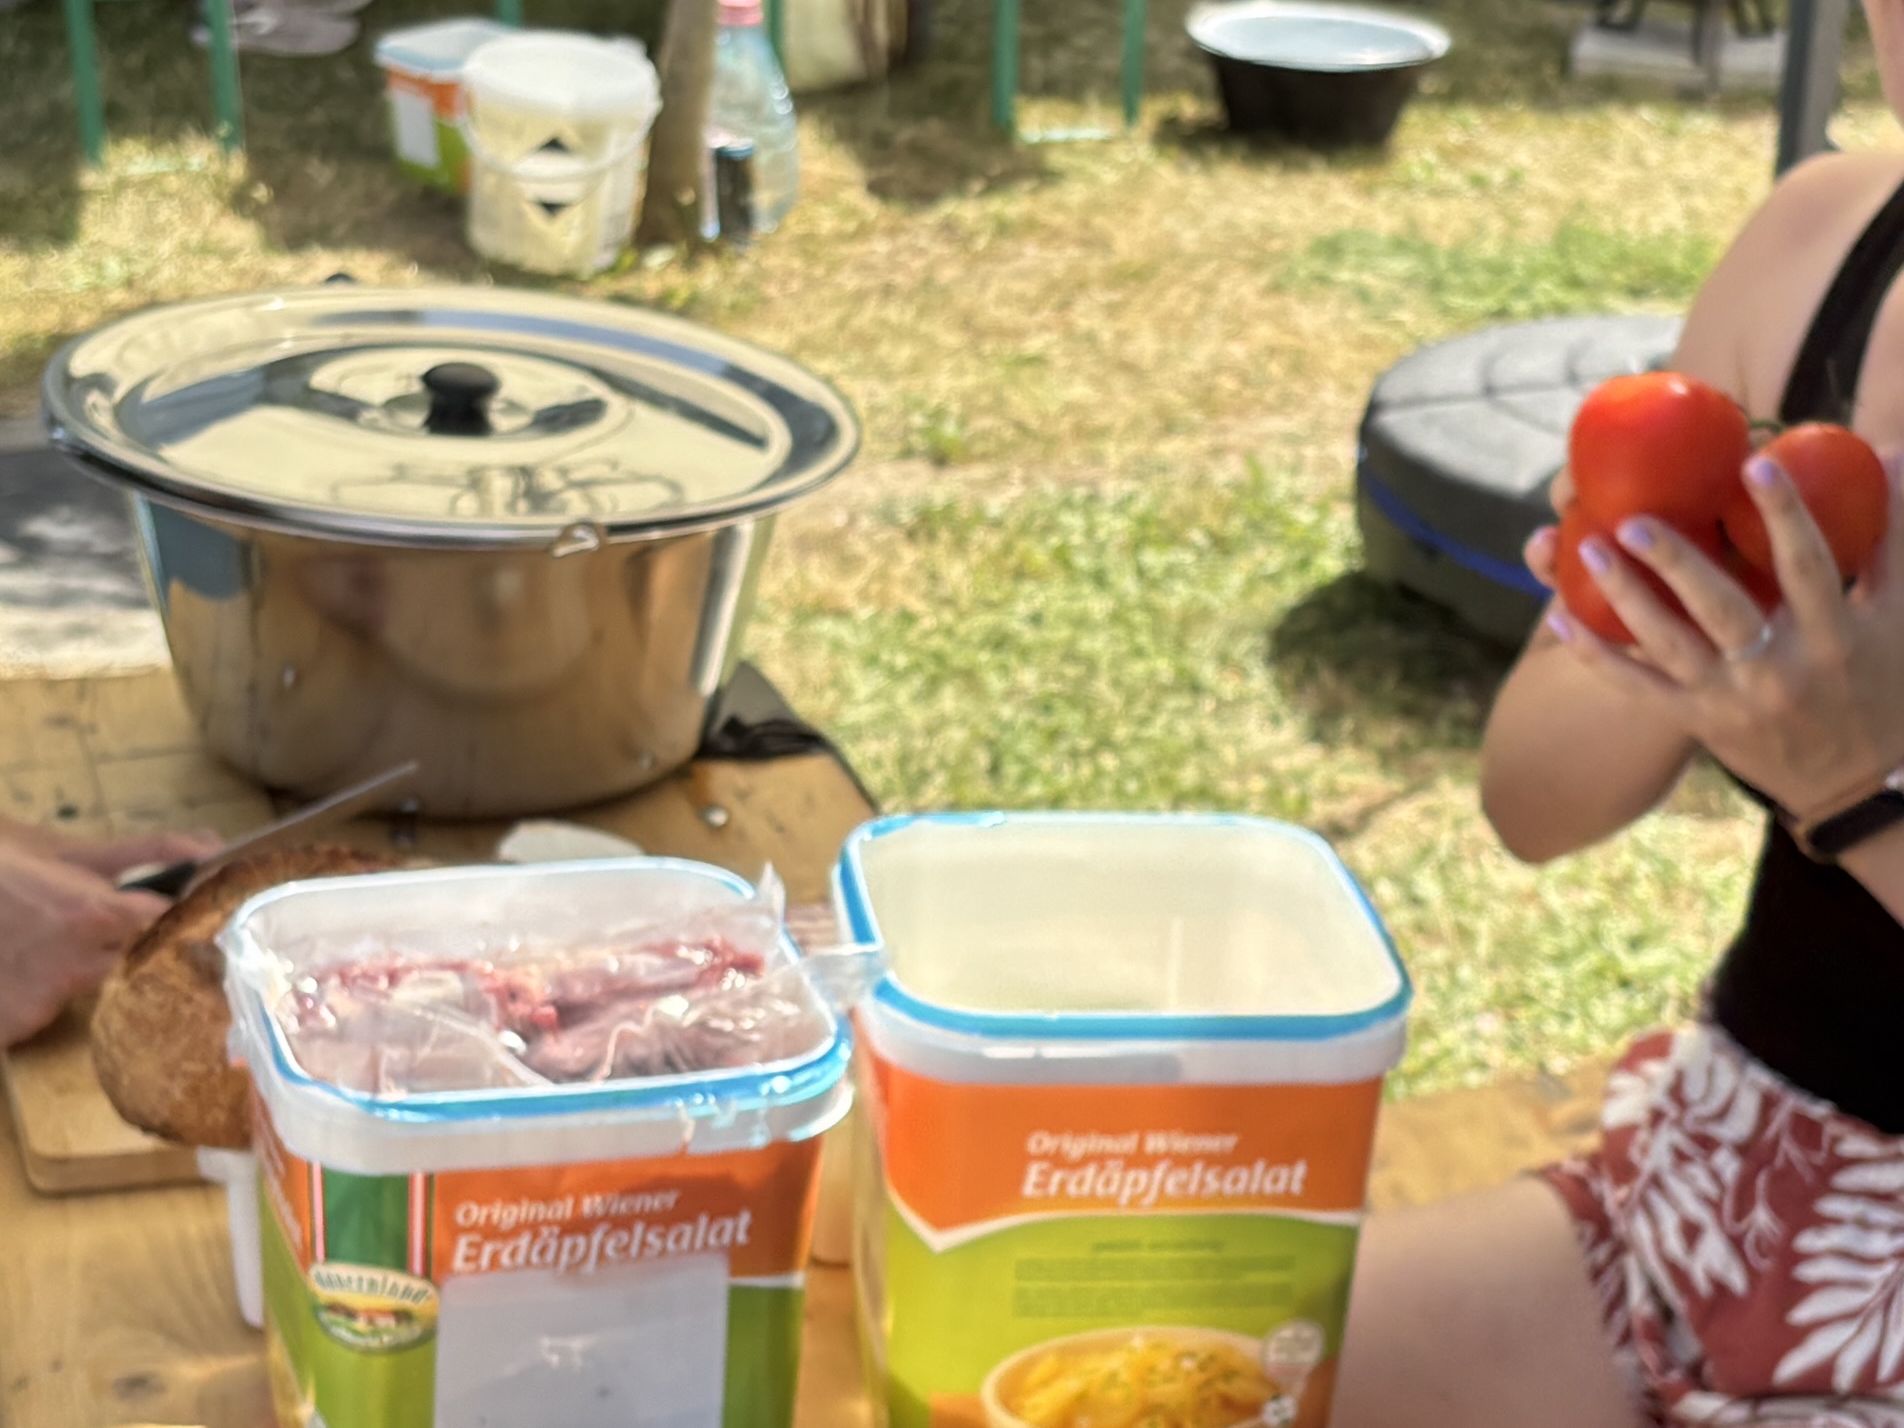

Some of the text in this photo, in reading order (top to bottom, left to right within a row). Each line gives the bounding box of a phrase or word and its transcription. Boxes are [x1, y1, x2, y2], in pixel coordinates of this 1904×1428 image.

[1026, 1131, 1240, 1158] Original Wiener
[1021, 1158, 1308, 1209] Erdäpfelsalat
[455, 1189, 680, 1229] Original Wiener
[452, 1209, 753, 1274] Erdäpfelsalat
